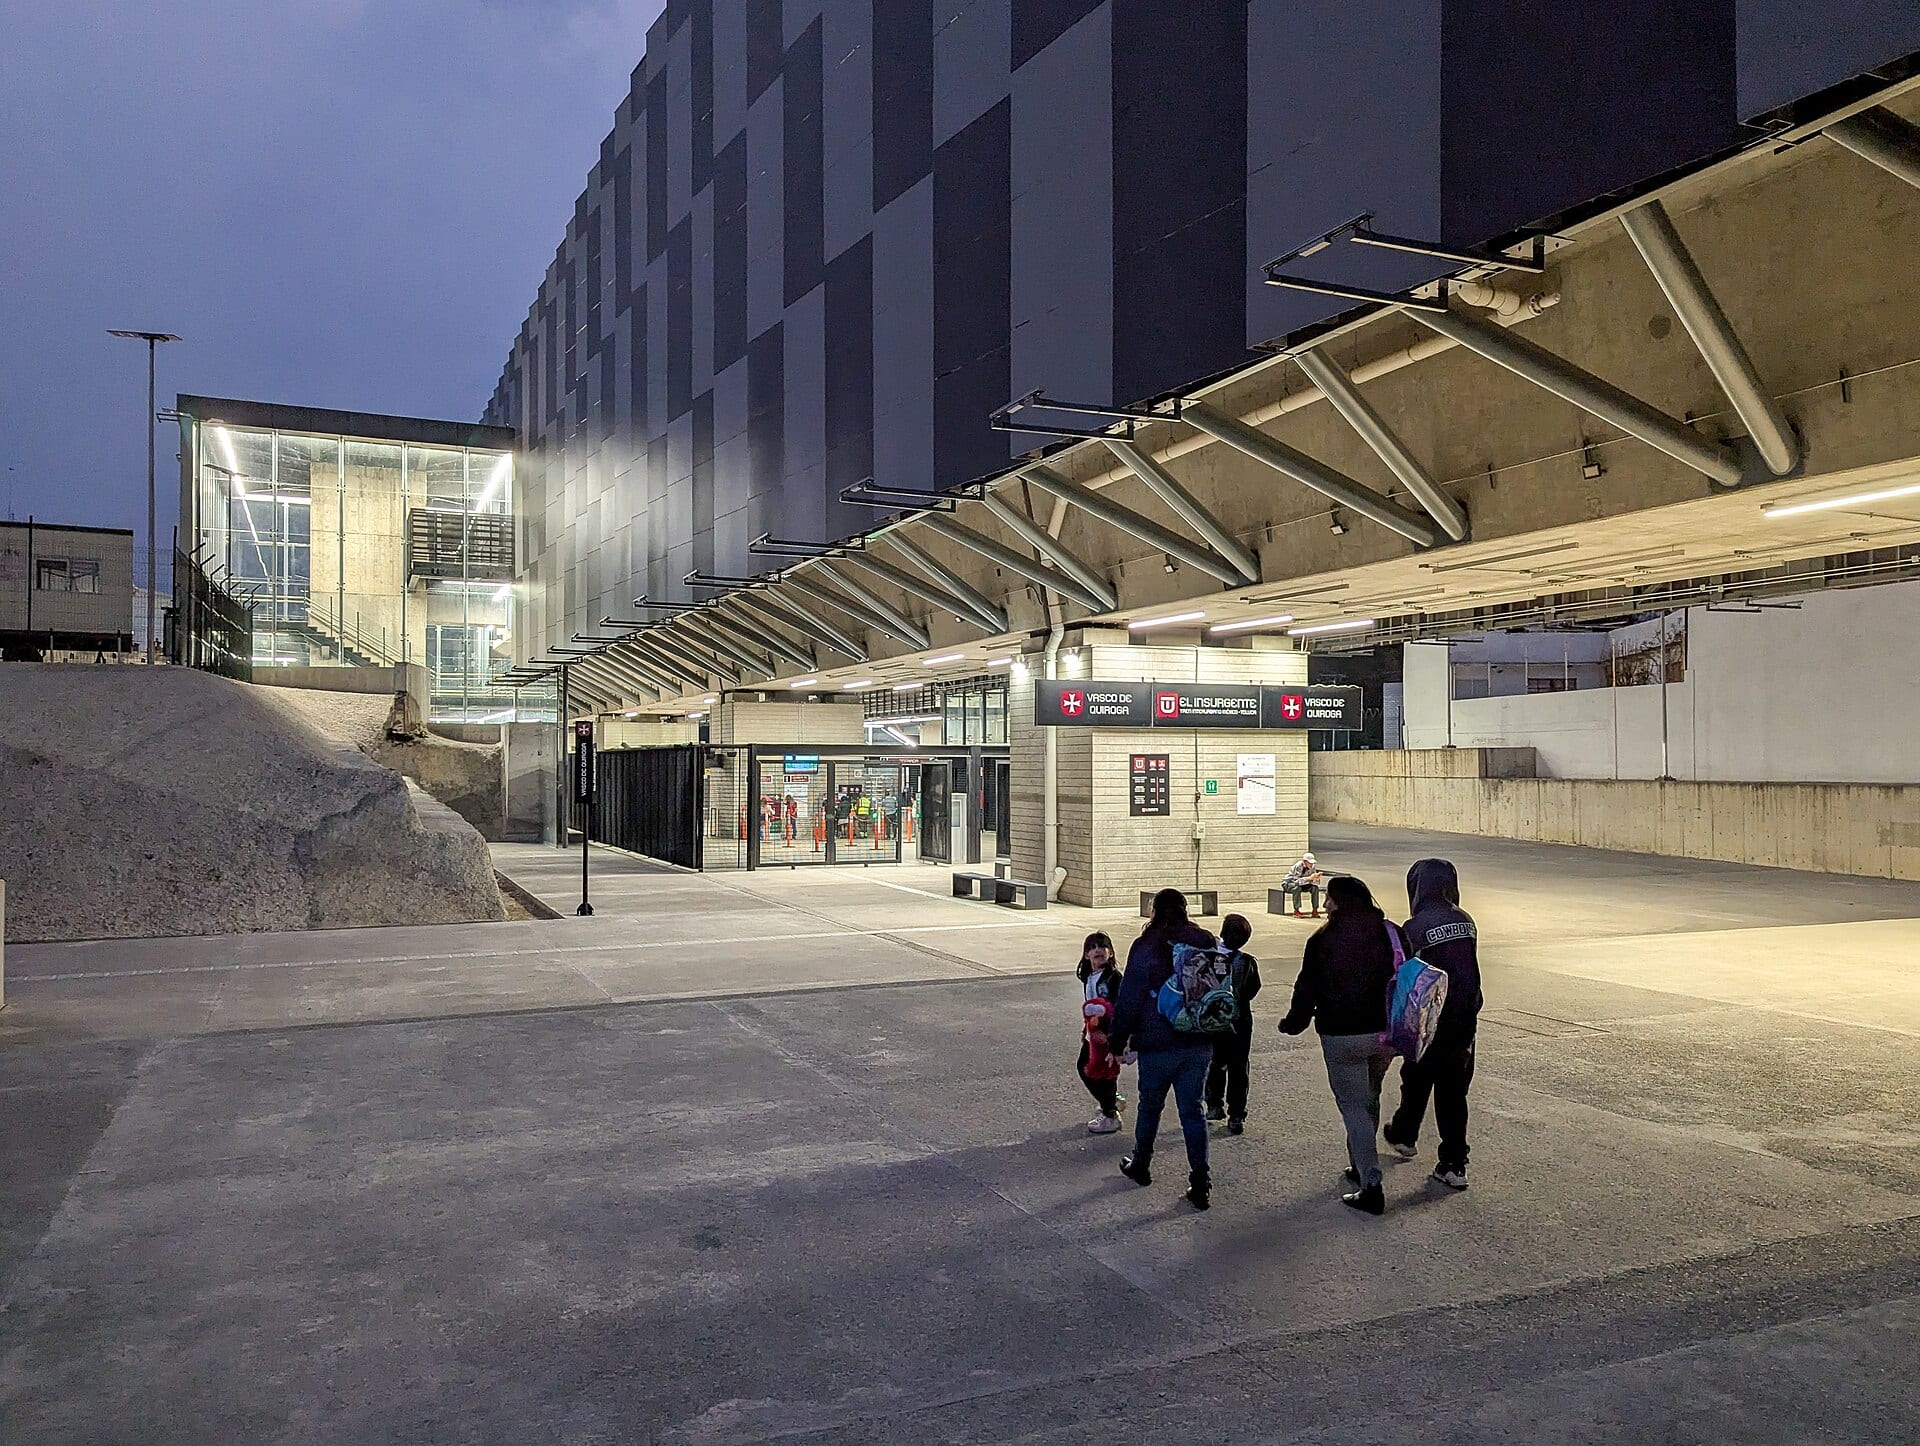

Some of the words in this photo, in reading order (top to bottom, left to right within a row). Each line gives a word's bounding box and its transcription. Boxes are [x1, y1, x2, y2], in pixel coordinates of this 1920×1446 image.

[1087, 693, 1116, 703] VASCO
[1119, 694, 1132, 703] DE
[1180, 697, 1192, 708] EL
[1194, 697, 1257, 709] INSURGENTE
[1304, 698, 1332, 707] VASCO
[1333, 698, 1345, 708] DE
[1090, 705, 1130, 715] QUIROGA
[1306, 709, 1342, 719] QUIROGA
